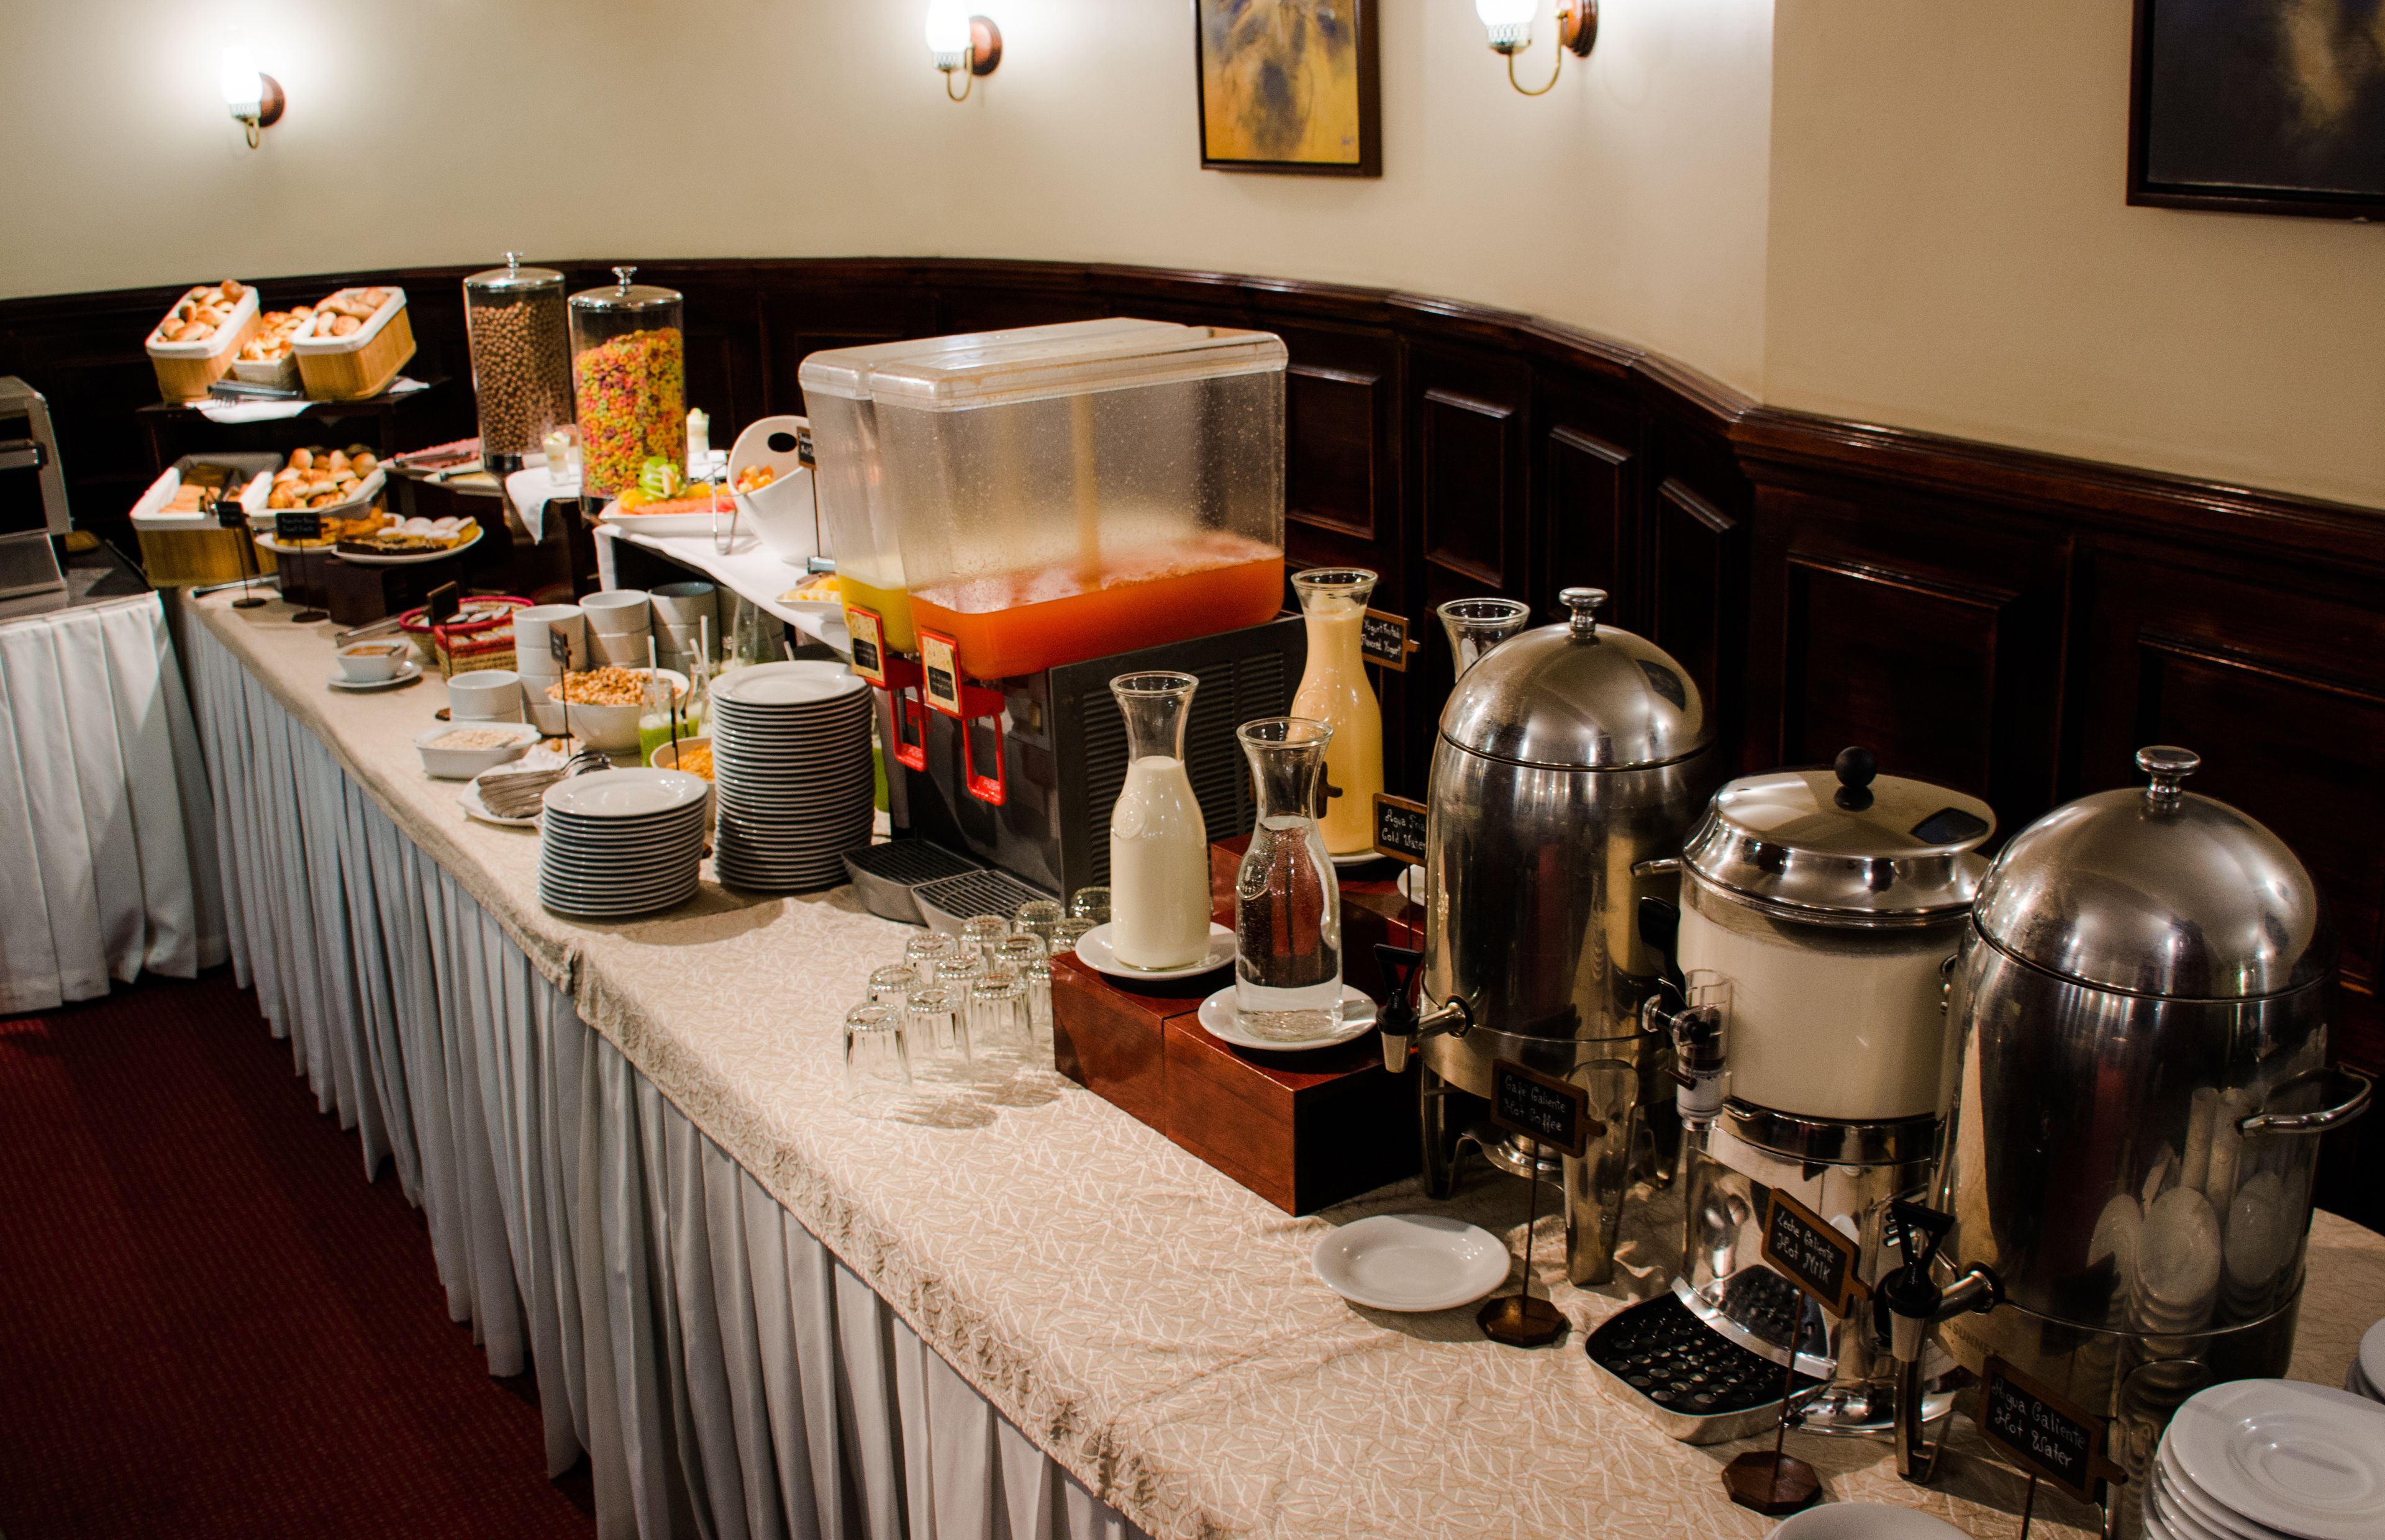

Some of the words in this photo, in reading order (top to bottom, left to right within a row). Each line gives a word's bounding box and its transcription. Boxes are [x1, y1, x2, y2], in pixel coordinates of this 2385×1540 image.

[1381, 828, 1399, 844] Cold
[1384, 808, 1407, 828] Agua
[1504, 1097, 1526, 1117] Hot
[1529, 1107, 1563, 1133] Coffee
[1531, 1086, 1566, 1113] Caliente
[1776, 1232, 1799, 1261] Hot
[1802, 1252, 1832, 1284] Milk
[1777, 1210, 1800, 1238] Leche
[1804, 1230, 1835, 1264] Caliente
[1991, 1377, 2027, 1416] Agua
[2032, 1401, 2086, 1451] Caliente
[1994, 1406, 2024, 1439] Hot
[2031, 1429, 2073, 1469] Water
